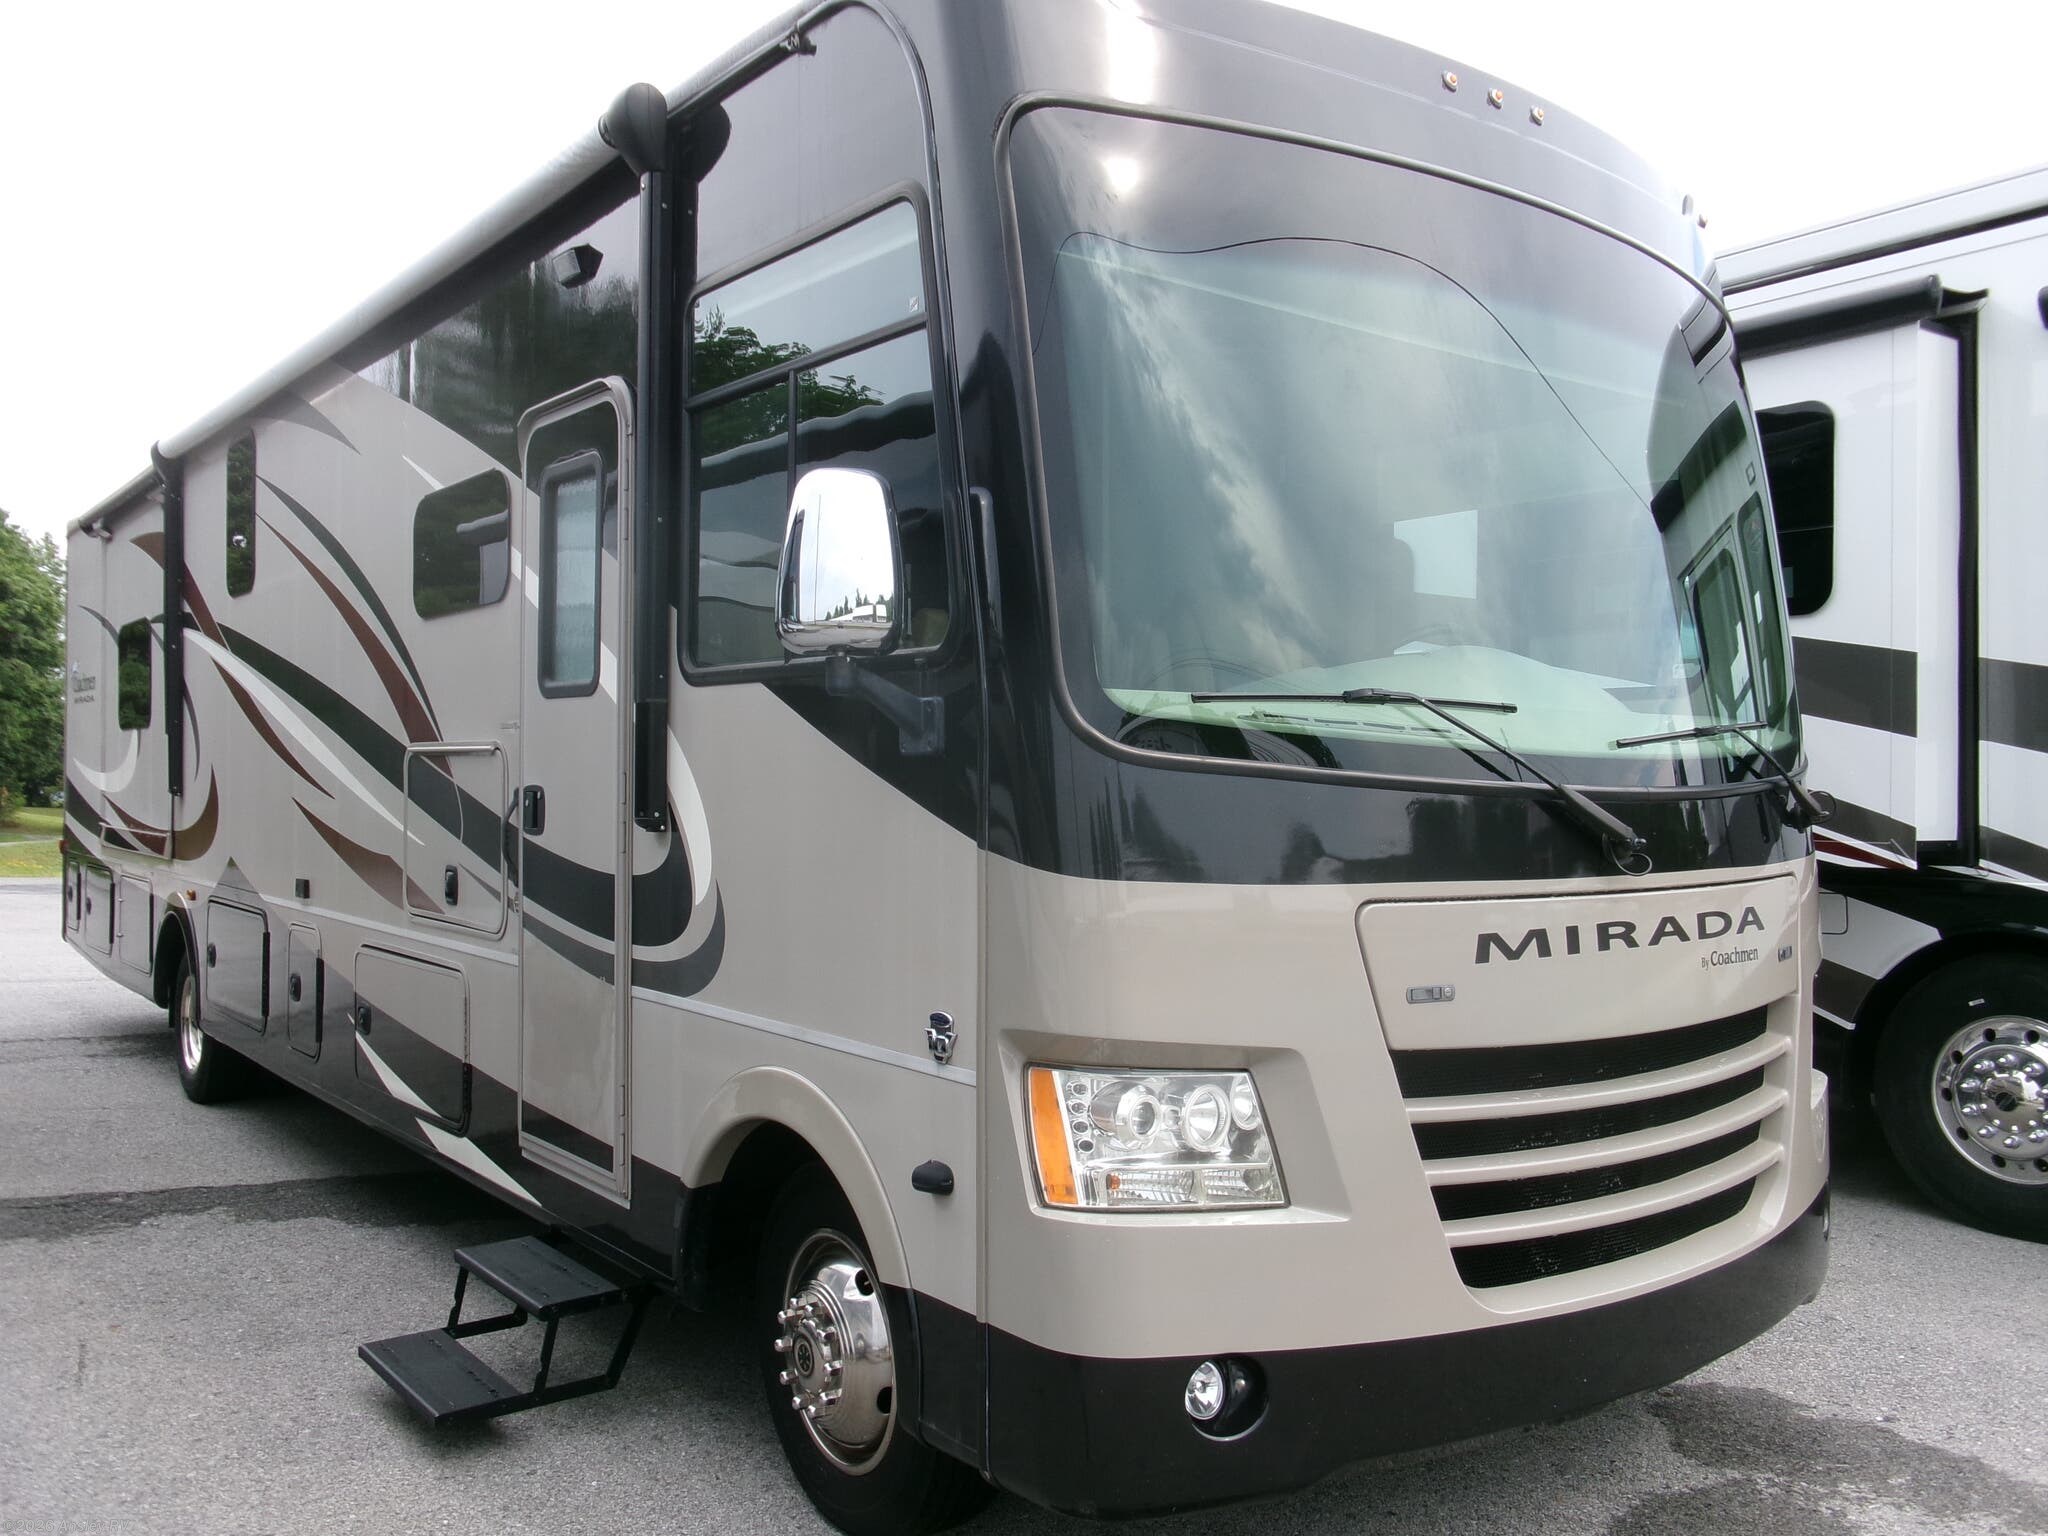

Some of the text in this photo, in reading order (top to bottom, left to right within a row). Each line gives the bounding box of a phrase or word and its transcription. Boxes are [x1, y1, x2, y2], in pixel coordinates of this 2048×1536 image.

[1475, 906, 1765, 964] MIRADA
[1701, 947, 1759, 971] By Coachmen
